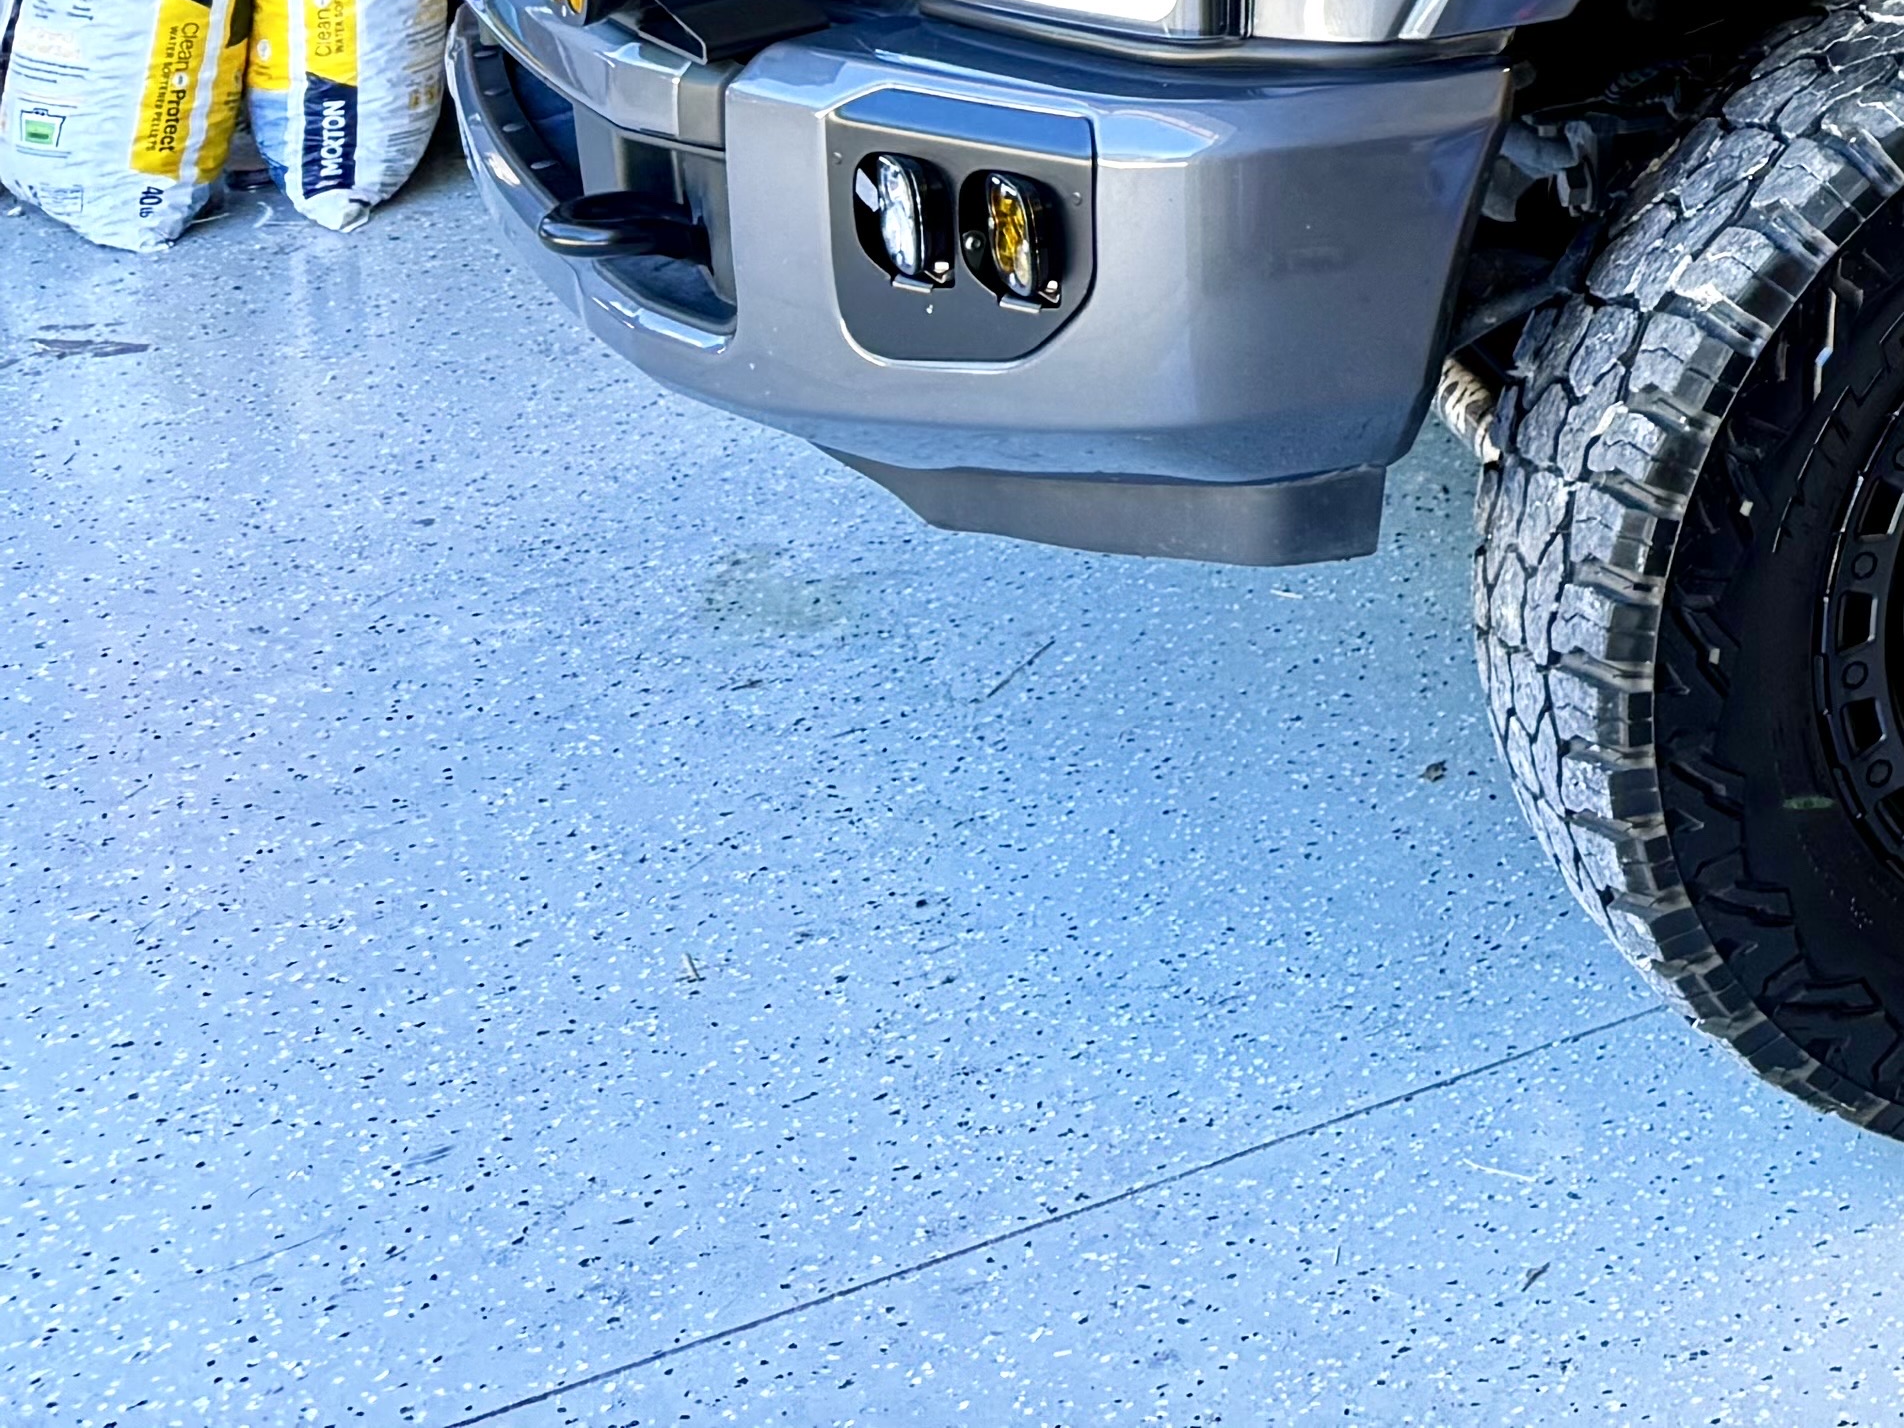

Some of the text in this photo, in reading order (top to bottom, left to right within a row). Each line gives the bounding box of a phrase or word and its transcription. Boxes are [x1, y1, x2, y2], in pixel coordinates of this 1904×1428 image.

[165, 26, 179, 58] WATER
[314, 7, 332, 57] Clean
[334, 20, 345, 54] WATER
[160, 22, 200, 153] Clean Protect
[146, 111, 165, 152] PELLETS
[139, 185, 163, 218] 40 lb
